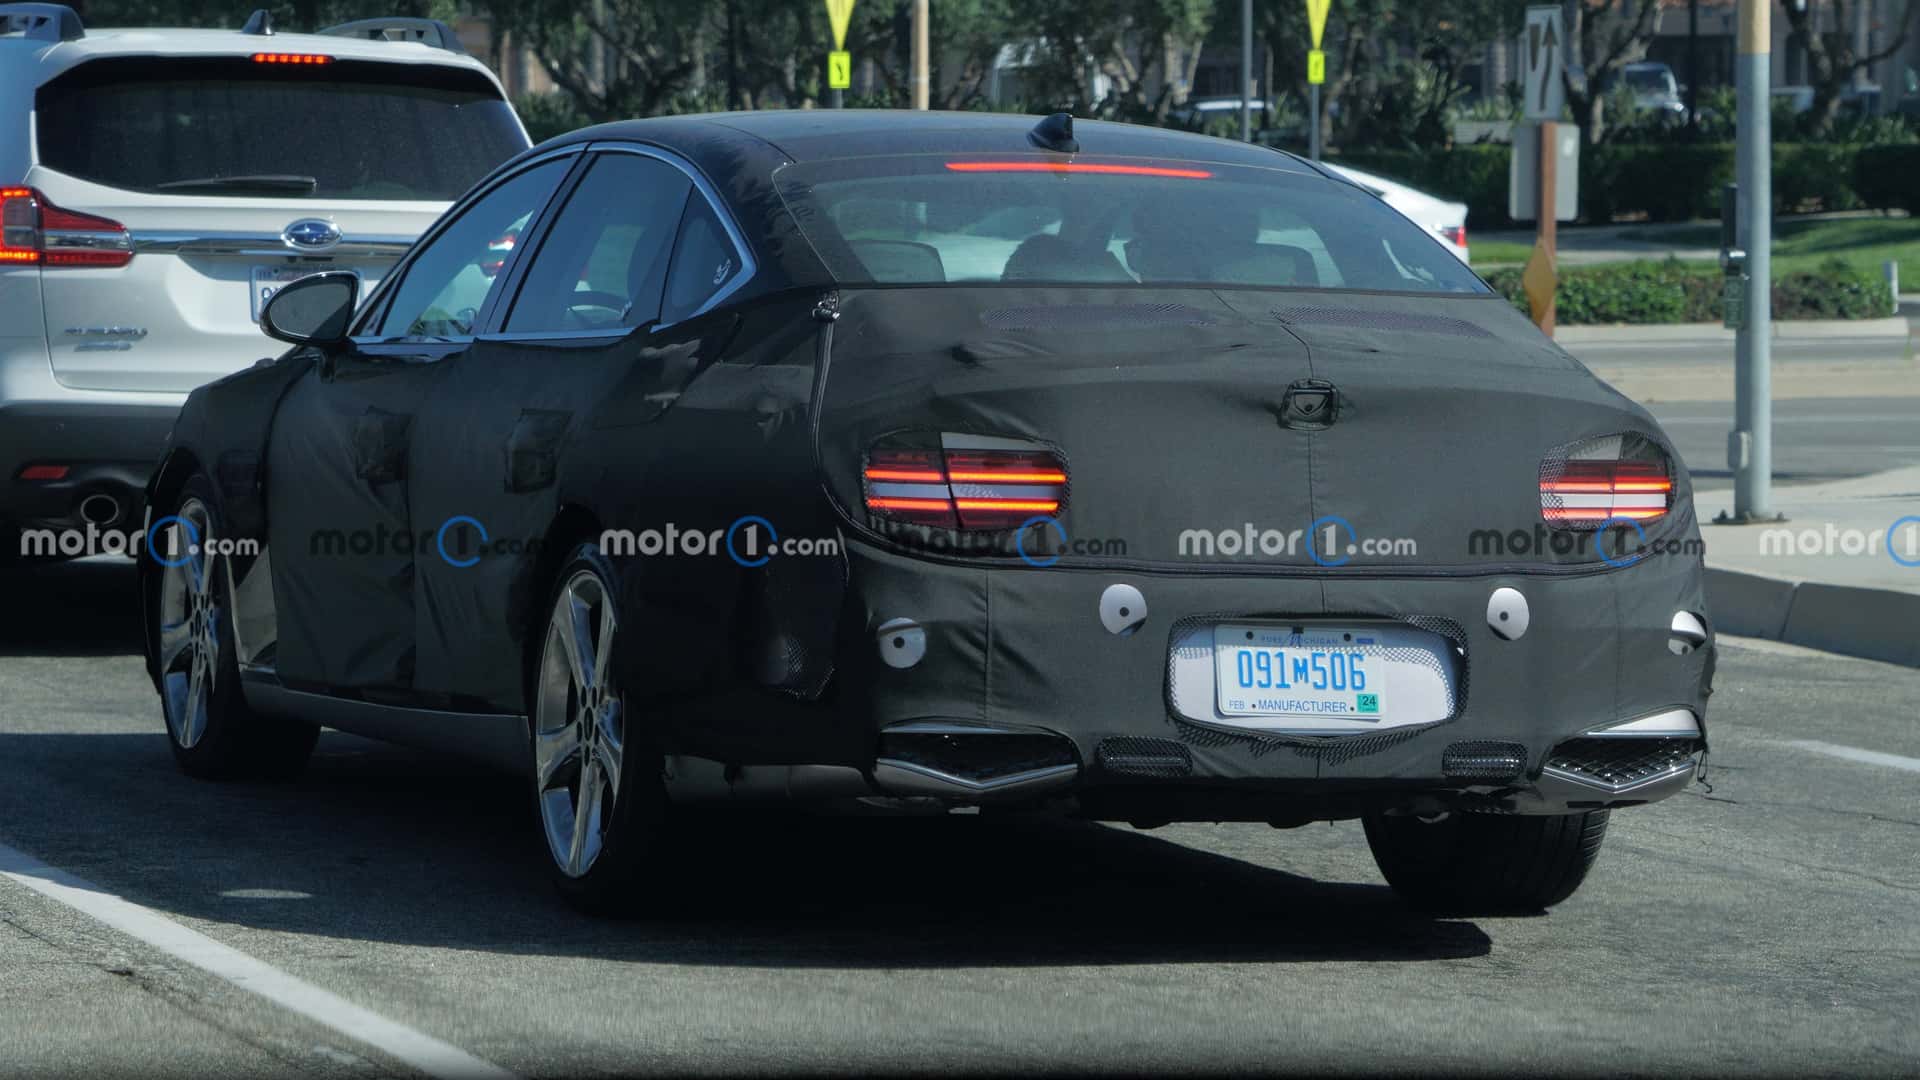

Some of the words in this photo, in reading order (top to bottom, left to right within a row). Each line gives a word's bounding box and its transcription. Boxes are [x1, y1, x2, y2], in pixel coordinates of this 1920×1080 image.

[1237, 650, 1366, 691] 091M506
[1229, 700, 1245, 710] FEB
[1258, 700, 1348, 713] MANUFACTURER
[1362, 695, 1377, 707] 24
